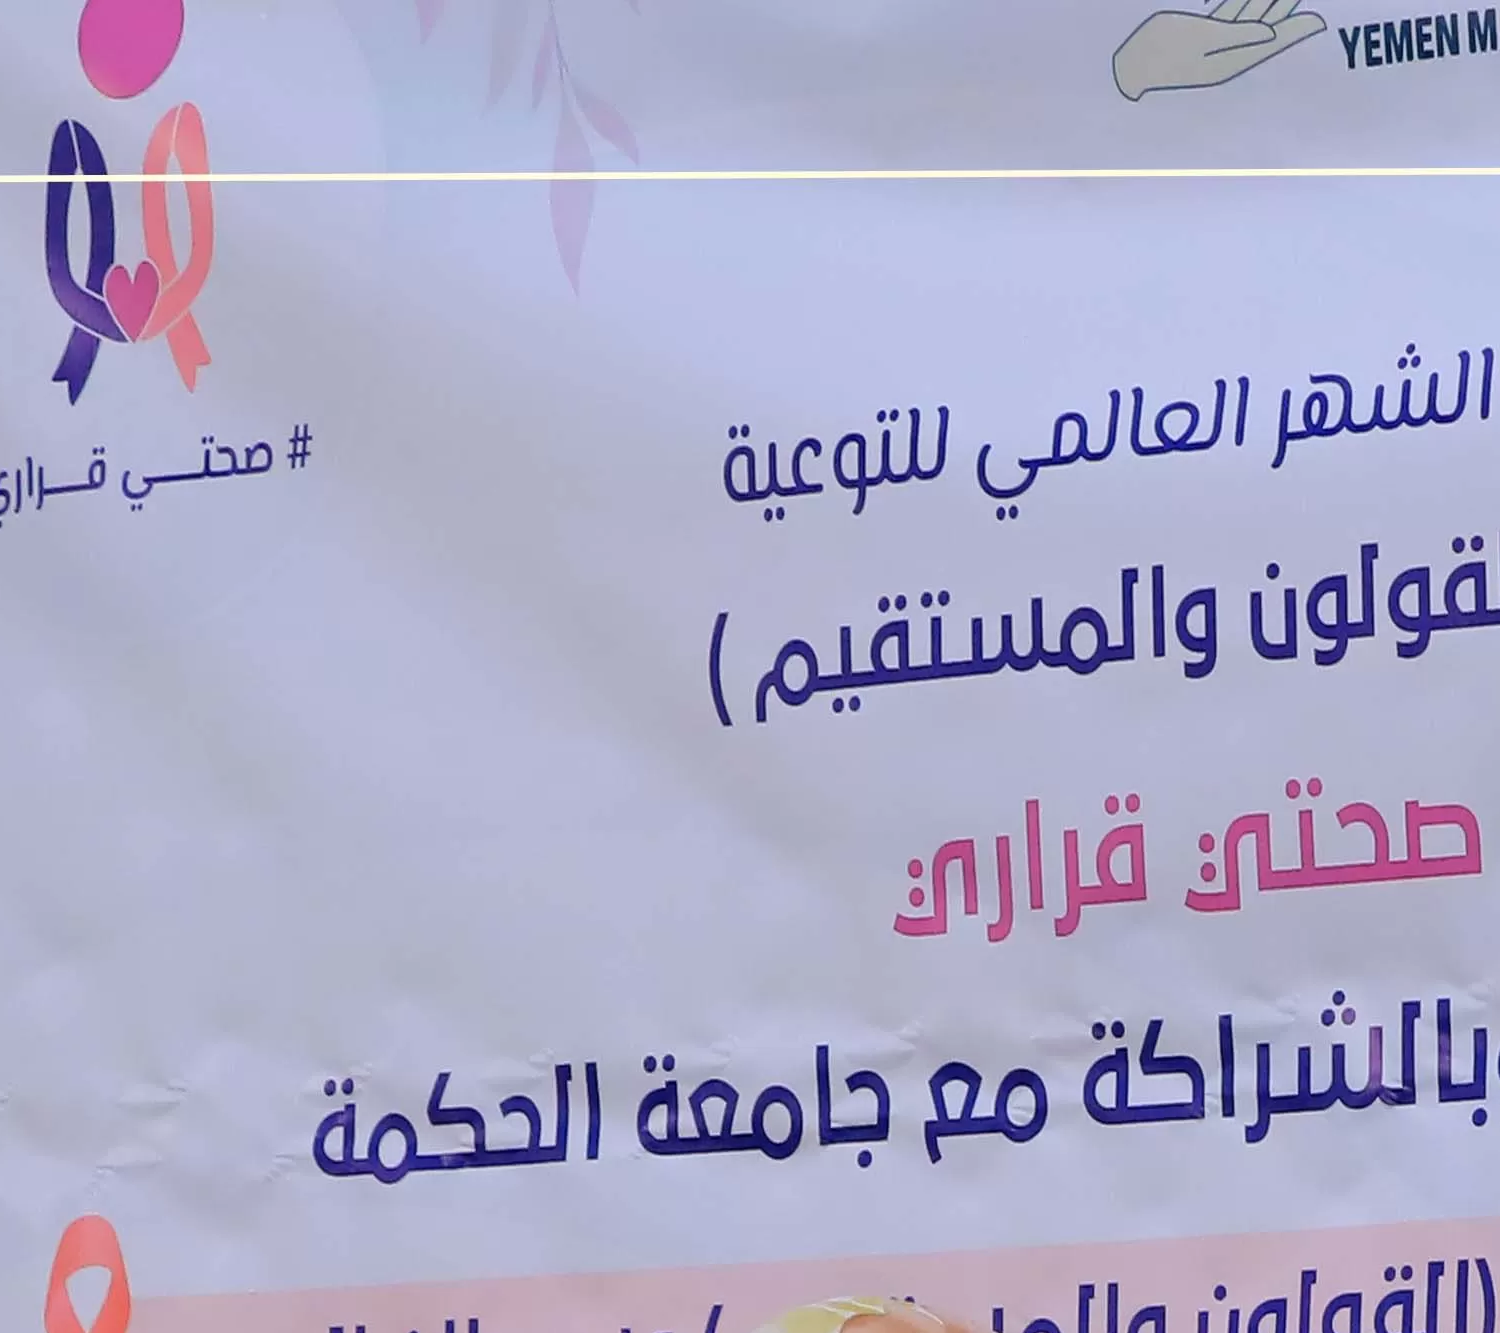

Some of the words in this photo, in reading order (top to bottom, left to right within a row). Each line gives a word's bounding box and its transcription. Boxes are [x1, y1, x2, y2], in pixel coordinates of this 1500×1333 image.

[1337, 13, 1461, 70] YEMEN
[723, 405, 951, 523] للتوعية
[976, 375, 1251, 522] العالمي
[1271, 342, 1495, 469] الشهر
[120, 435, 273, 512] صحتي
[754, 564, 1219, 725] والمستقيم
[892, 792, 1148, 943] قراري
[1183, 776, 1484, 913] صحتي
[311, 1060, 601, 1186] الحكمة
[635, 1044, 891, 1170] جامعة
[922, 1059, 1049, 1166] مع
